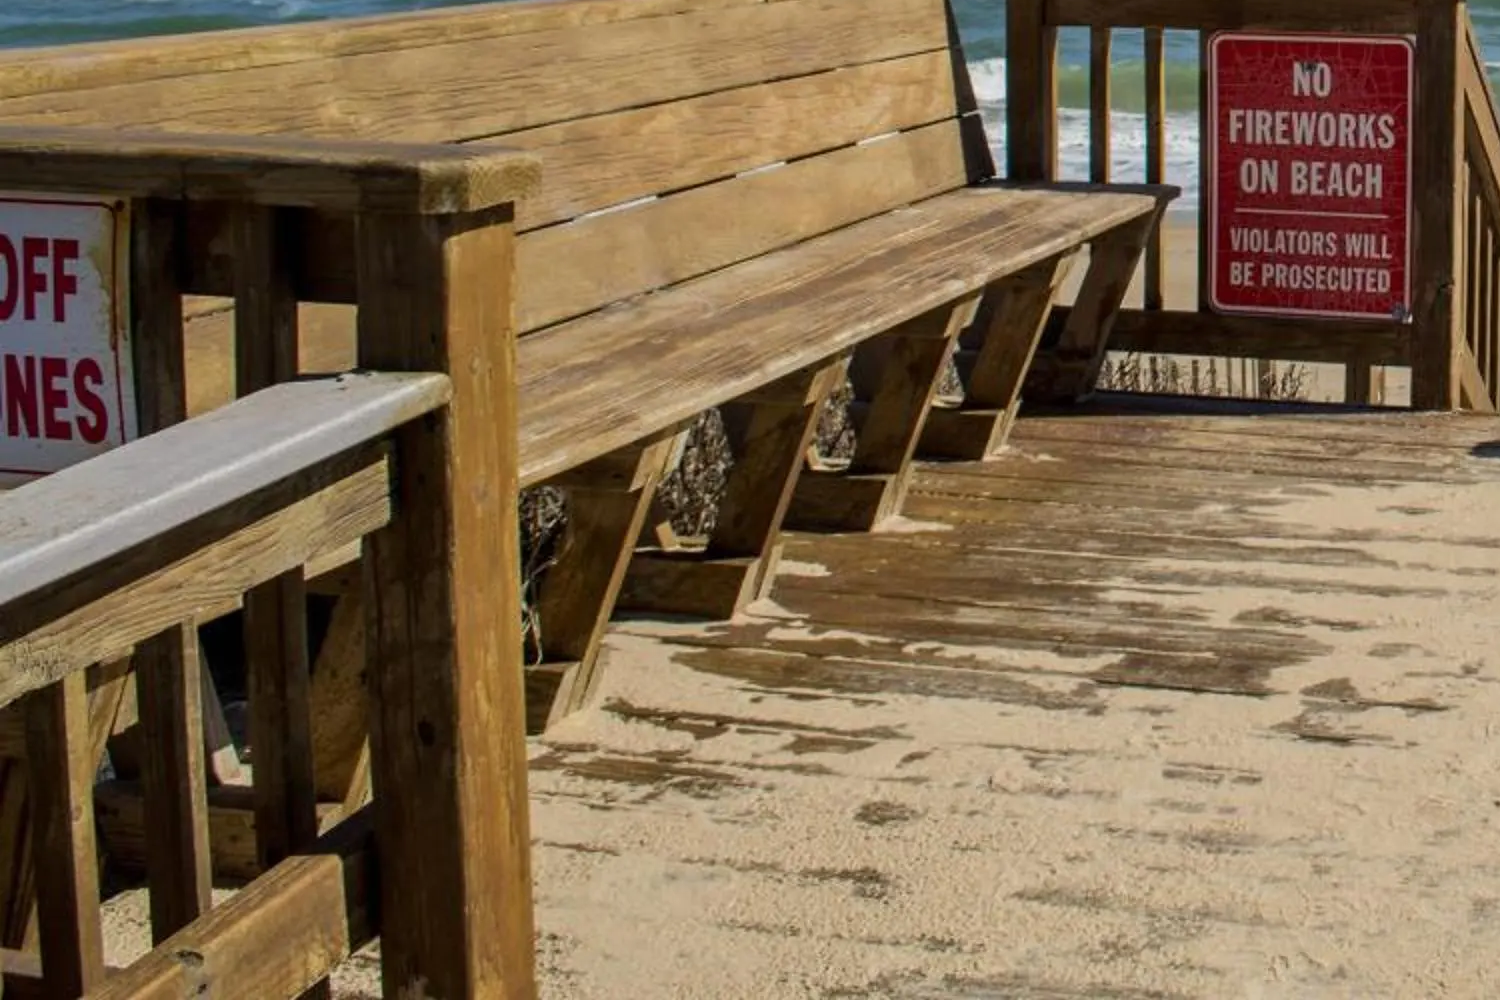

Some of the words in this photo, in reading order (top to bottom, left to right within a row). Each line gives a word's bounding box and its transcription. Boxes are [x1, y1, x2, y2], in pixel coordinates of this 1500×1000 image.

[1293, 61, 1331, 97] NO
[1229, 109, 1396, 149] FIREWORKS
[1240, 159, 1278, 194] ON
[1291, 162, 1383, 199] BEACH
[1230, 227, 1337, 257] VIOLATORS
[1345, 233, 1393, 260] WILL
[1230, 262, 1255, 286] BE
[1261, 265, 1392, 293] PROSECUTED
[0, 354, 109, 444] NES
